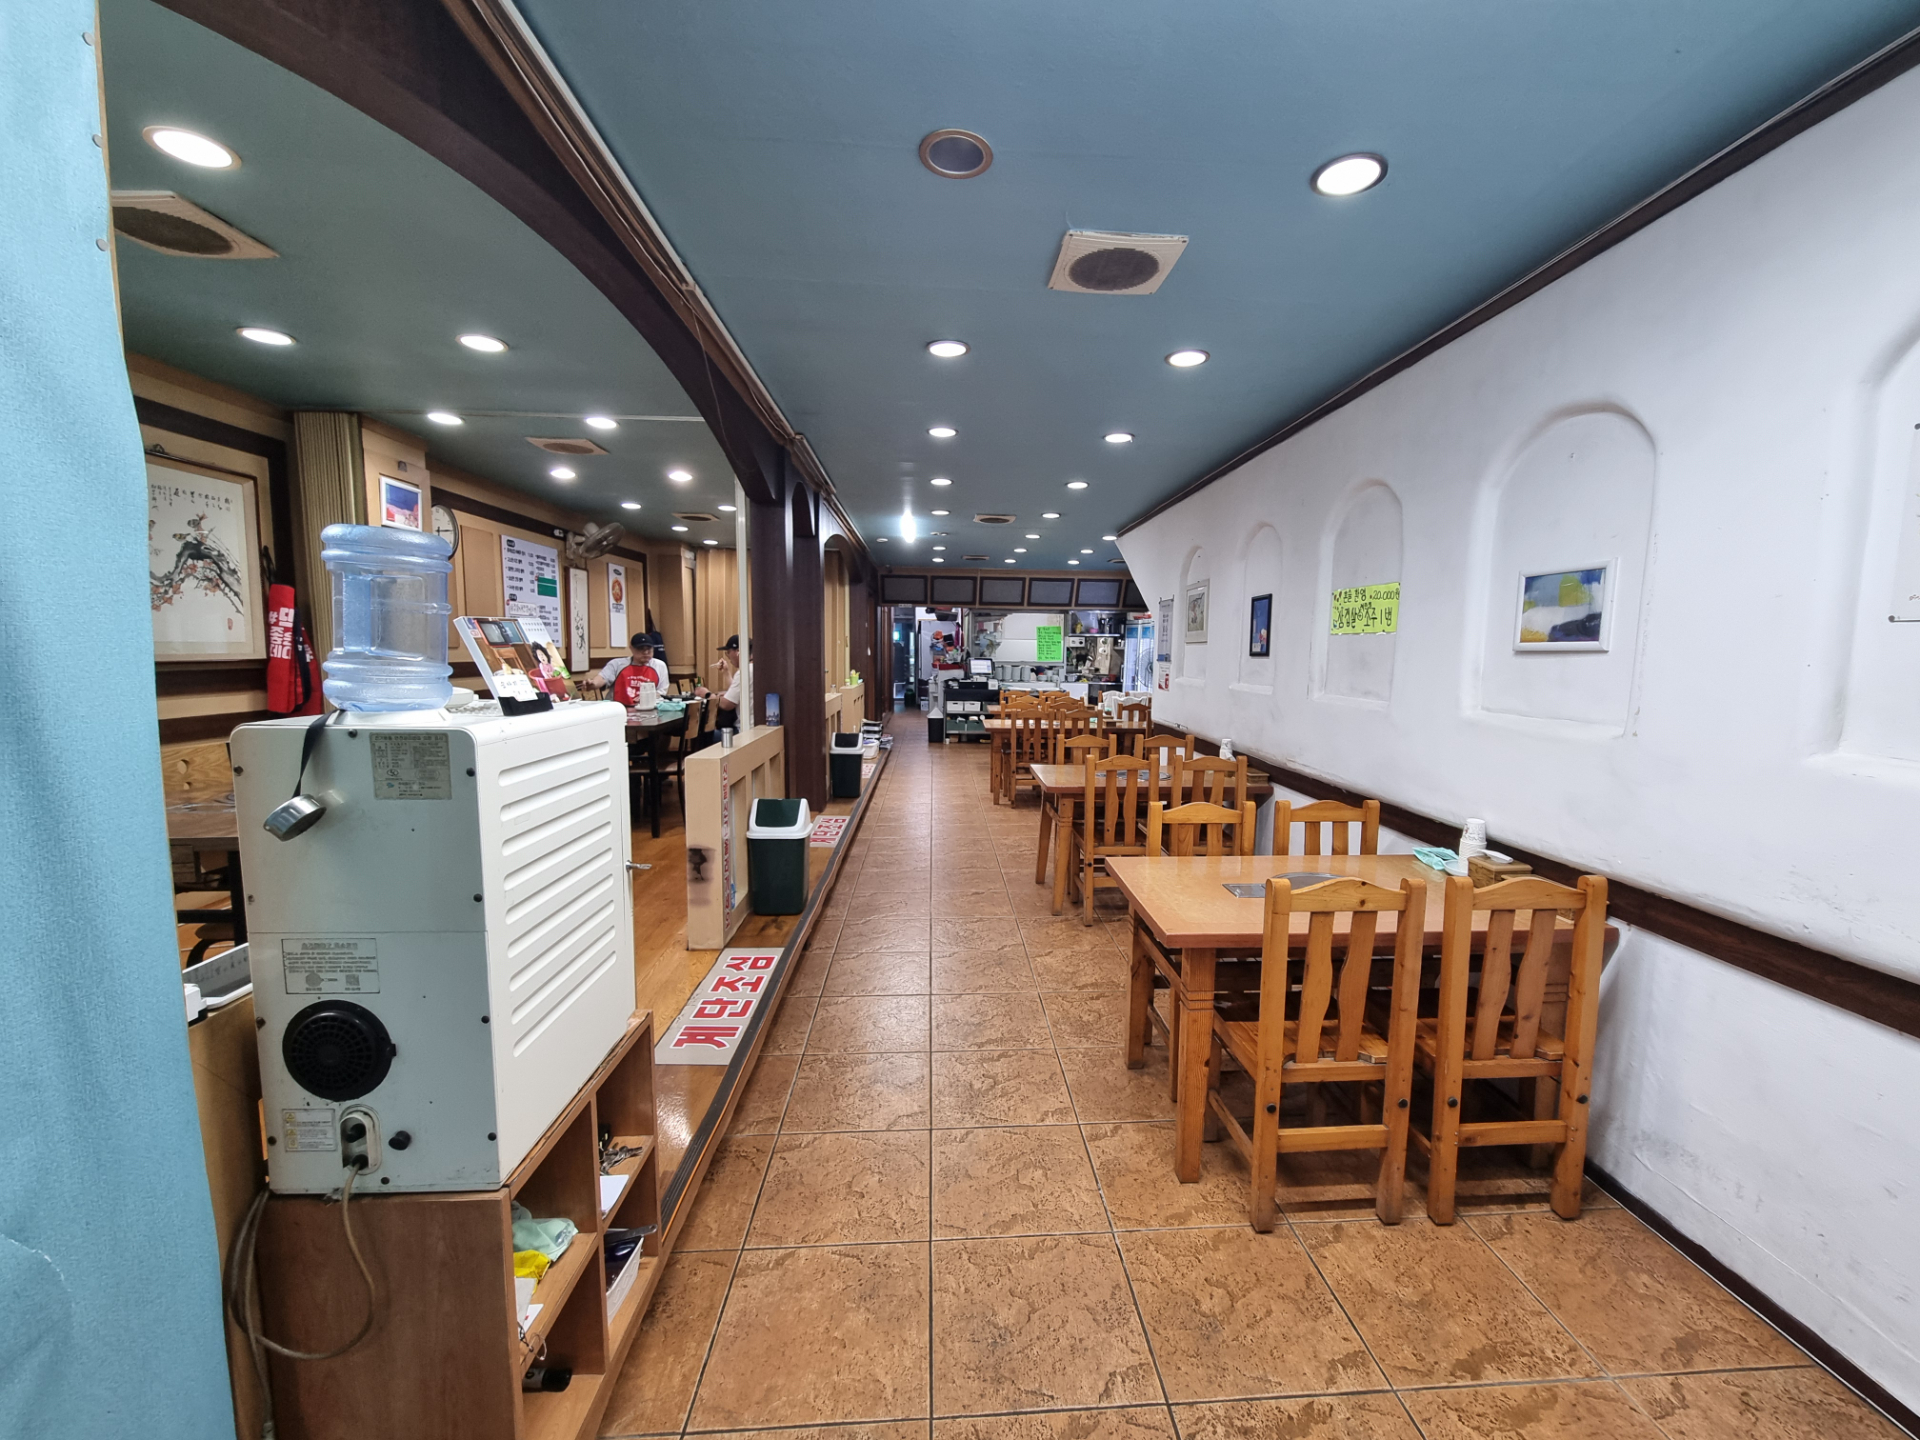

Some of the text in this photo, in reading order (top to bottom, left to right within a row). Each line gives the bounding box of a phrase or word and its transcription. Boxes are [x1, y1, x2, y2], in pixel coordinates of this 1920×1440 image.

[1354, 588, 1367, 603] 환영
[1364, 607, 1378, 628] 소주
[810, 817, 847, 844] 계단조심
[672, 955, 776, 1049] 계단조심
